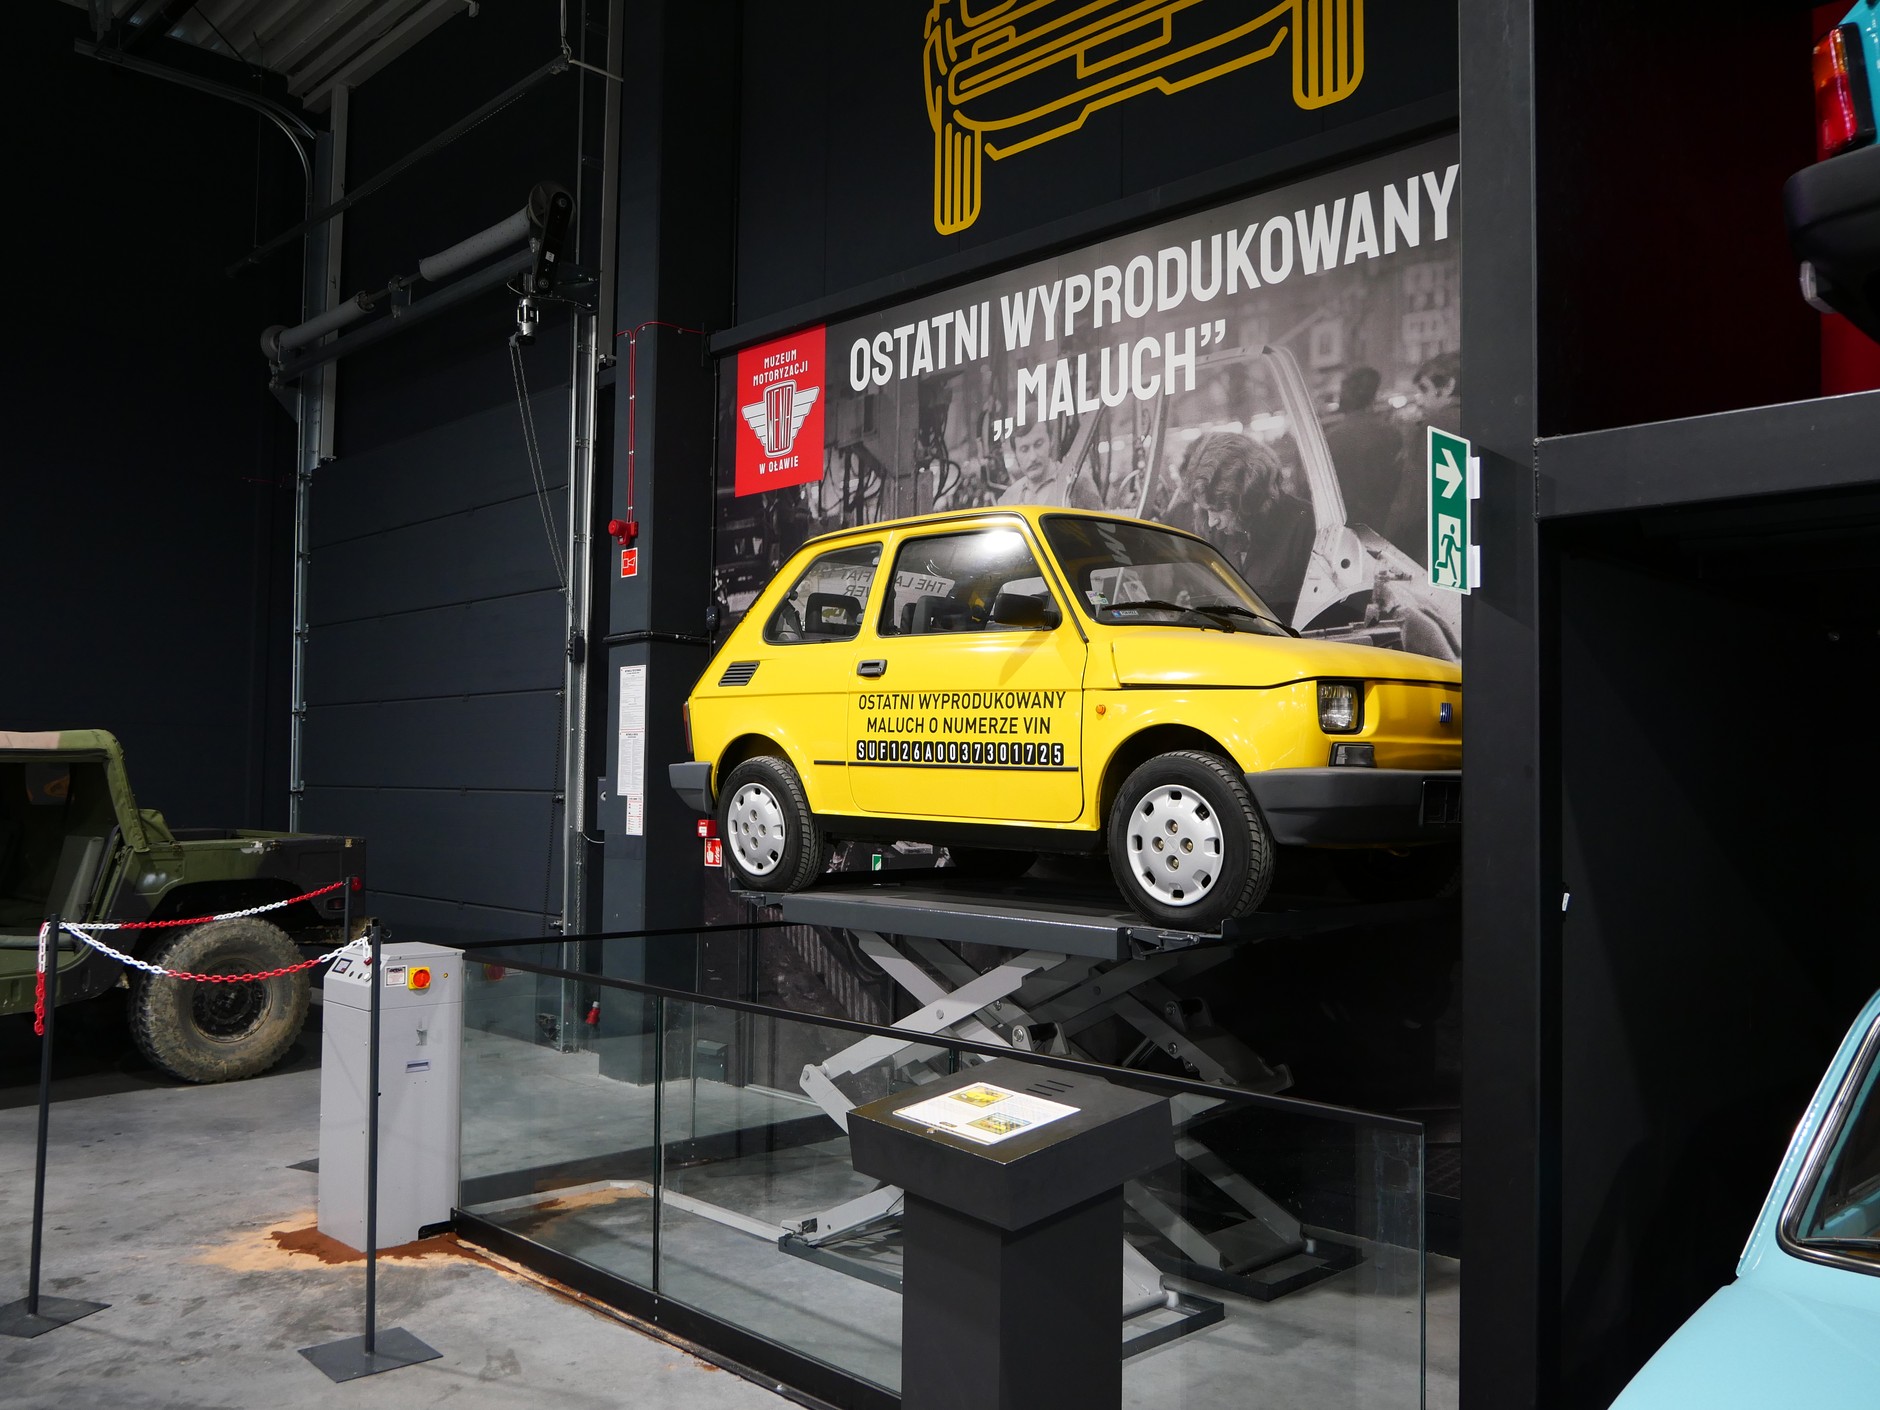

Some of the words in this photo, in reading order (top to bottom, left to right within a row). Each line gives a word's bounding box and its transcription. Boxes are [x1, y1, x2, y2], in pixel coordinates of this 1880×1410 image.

[850, 302, 990, 393] OSTATNI
[1000, 164, 1460, 353] WYPRODUKOWANY
[764, 349, 797, 369] MUZEUM
[753, 360, 808, 386] MOTORYZACJI
[759, 463, 766, 475] W
[768, 455, 799, 473] OŁAWIE
[858, 694, 914, 710] OSTATNI
[919, 691, 1066, 710] WYPRODUKOWANY
[866, 717, 924, 733] MALUCH
[929, 717, 938, 733] O
[943, 717, 1018, 734] NUMERZE
[1023, 717, 1051, 735] VIN
[857, 741, 1062, 763] SUF126A0037301725
